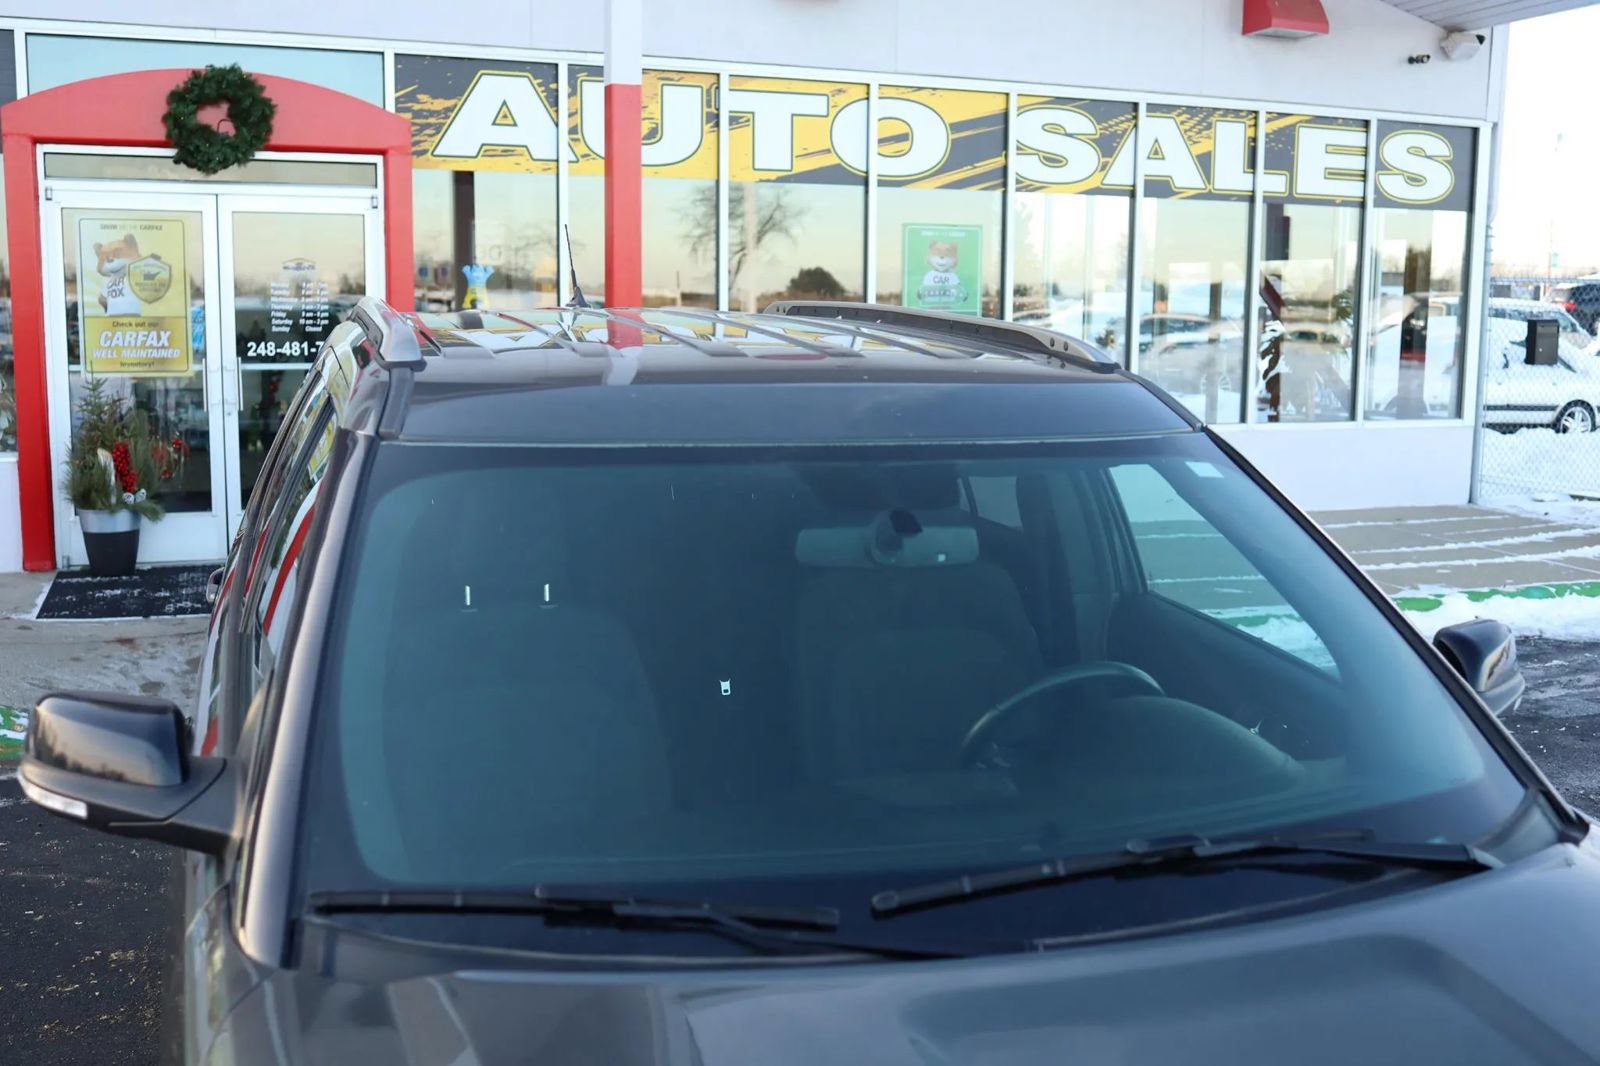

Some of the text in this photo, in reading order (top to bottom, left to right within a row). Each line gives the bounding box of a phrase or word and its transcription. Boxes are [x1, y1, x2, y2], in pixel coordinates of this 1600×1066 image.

[431, 70, 1455, 203] AUTO SALES
[933, 275, 950, 284] CAR
[106, 287, 125, 299] FOX
[112, 320, 133, 328] Check
[100, 330, 172, 348] CARFAX
[93, 348, 181, 359] WELL MAINTAINED
